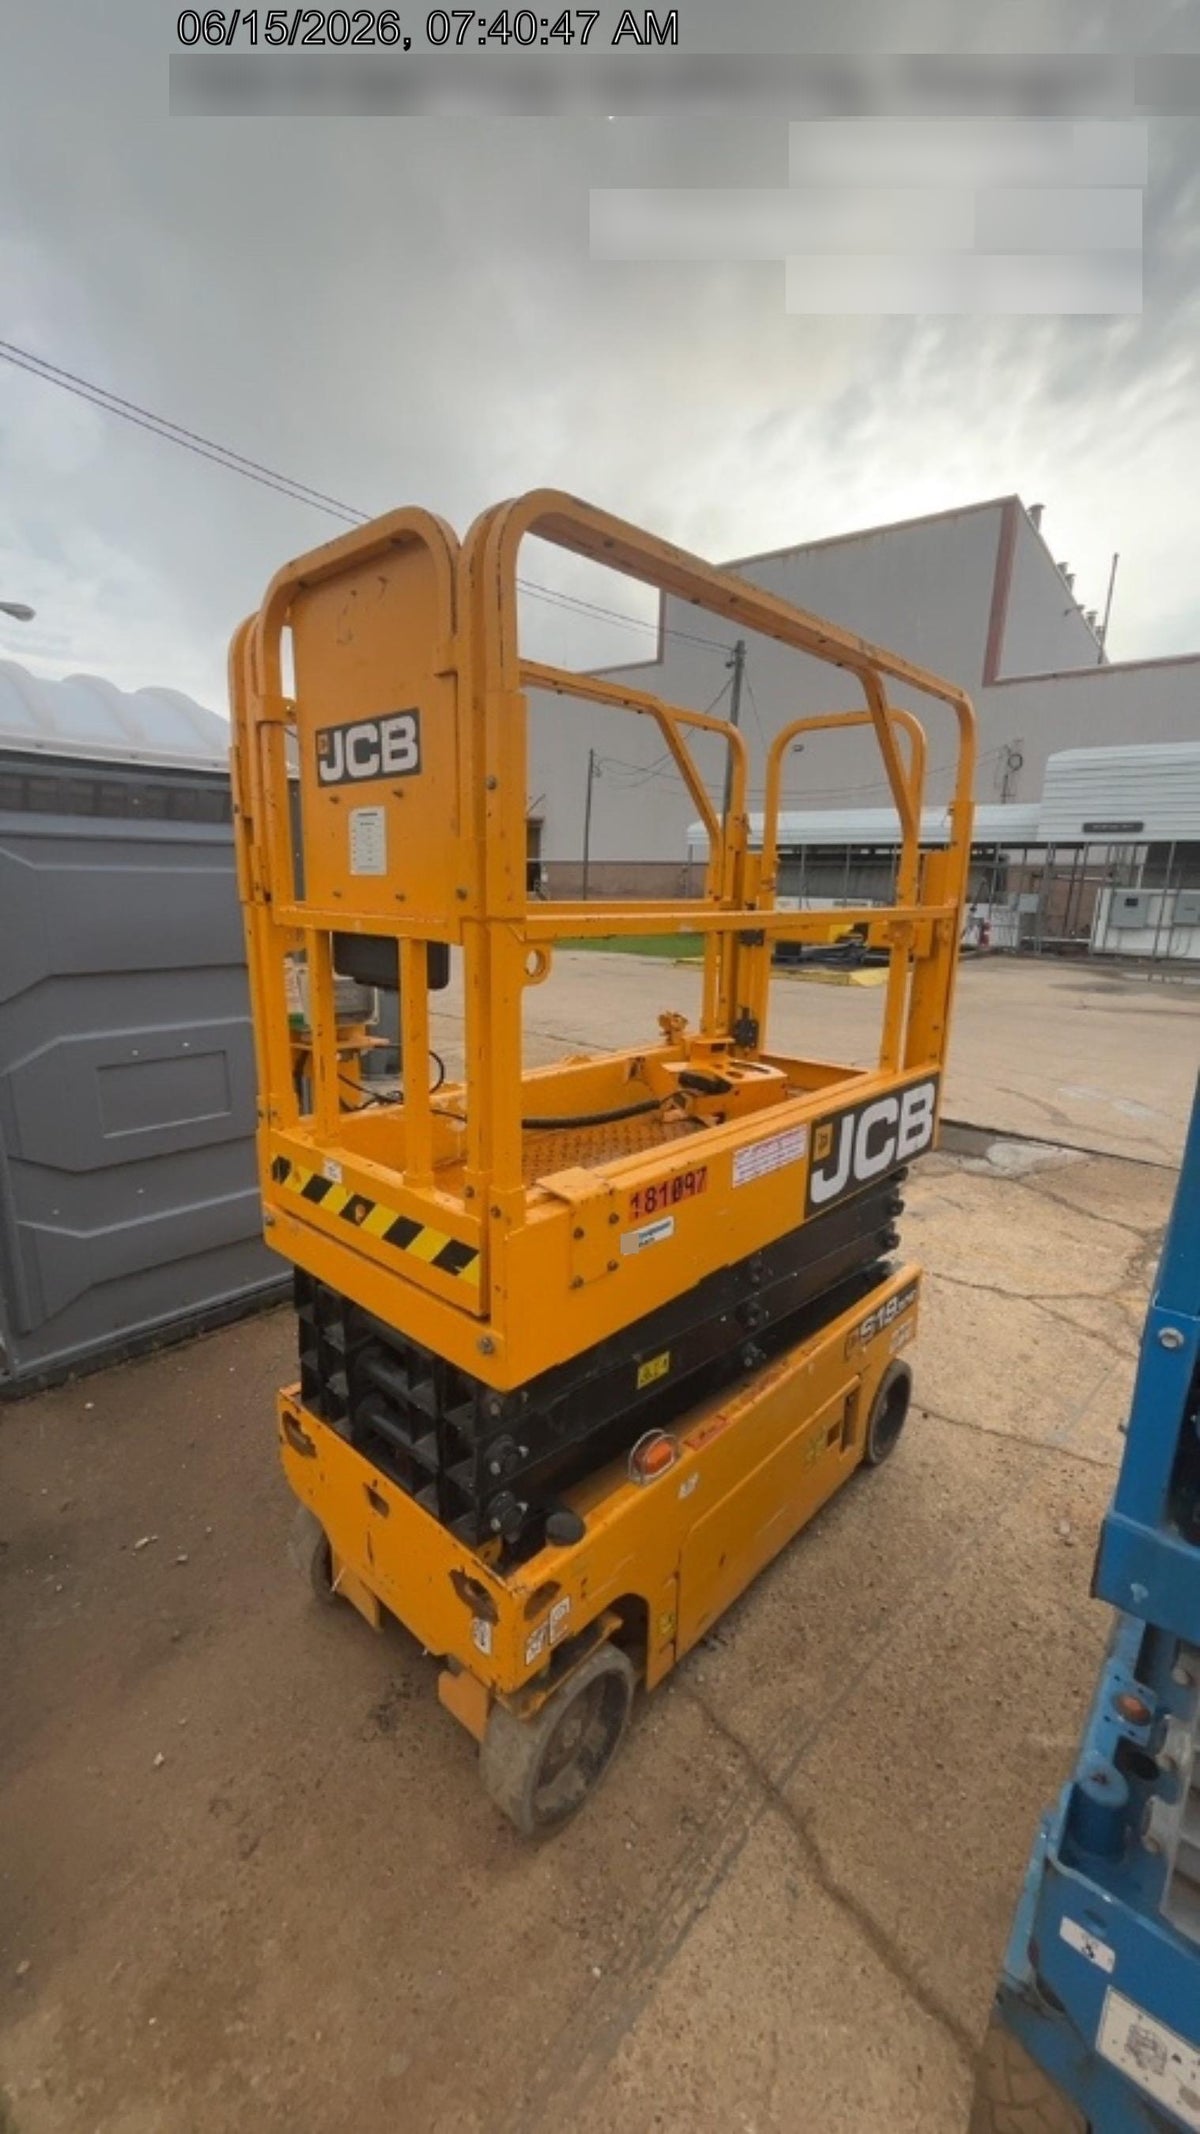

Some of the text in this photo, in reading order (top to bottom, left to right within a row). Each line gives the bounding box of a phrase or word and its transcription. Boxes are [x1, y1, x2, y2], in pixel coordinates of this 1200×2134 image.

[320, 716, 418, 781] JCB
[811, 1083, 935, 1203] JCB
[630, 1165, 707, 1219] 181097
